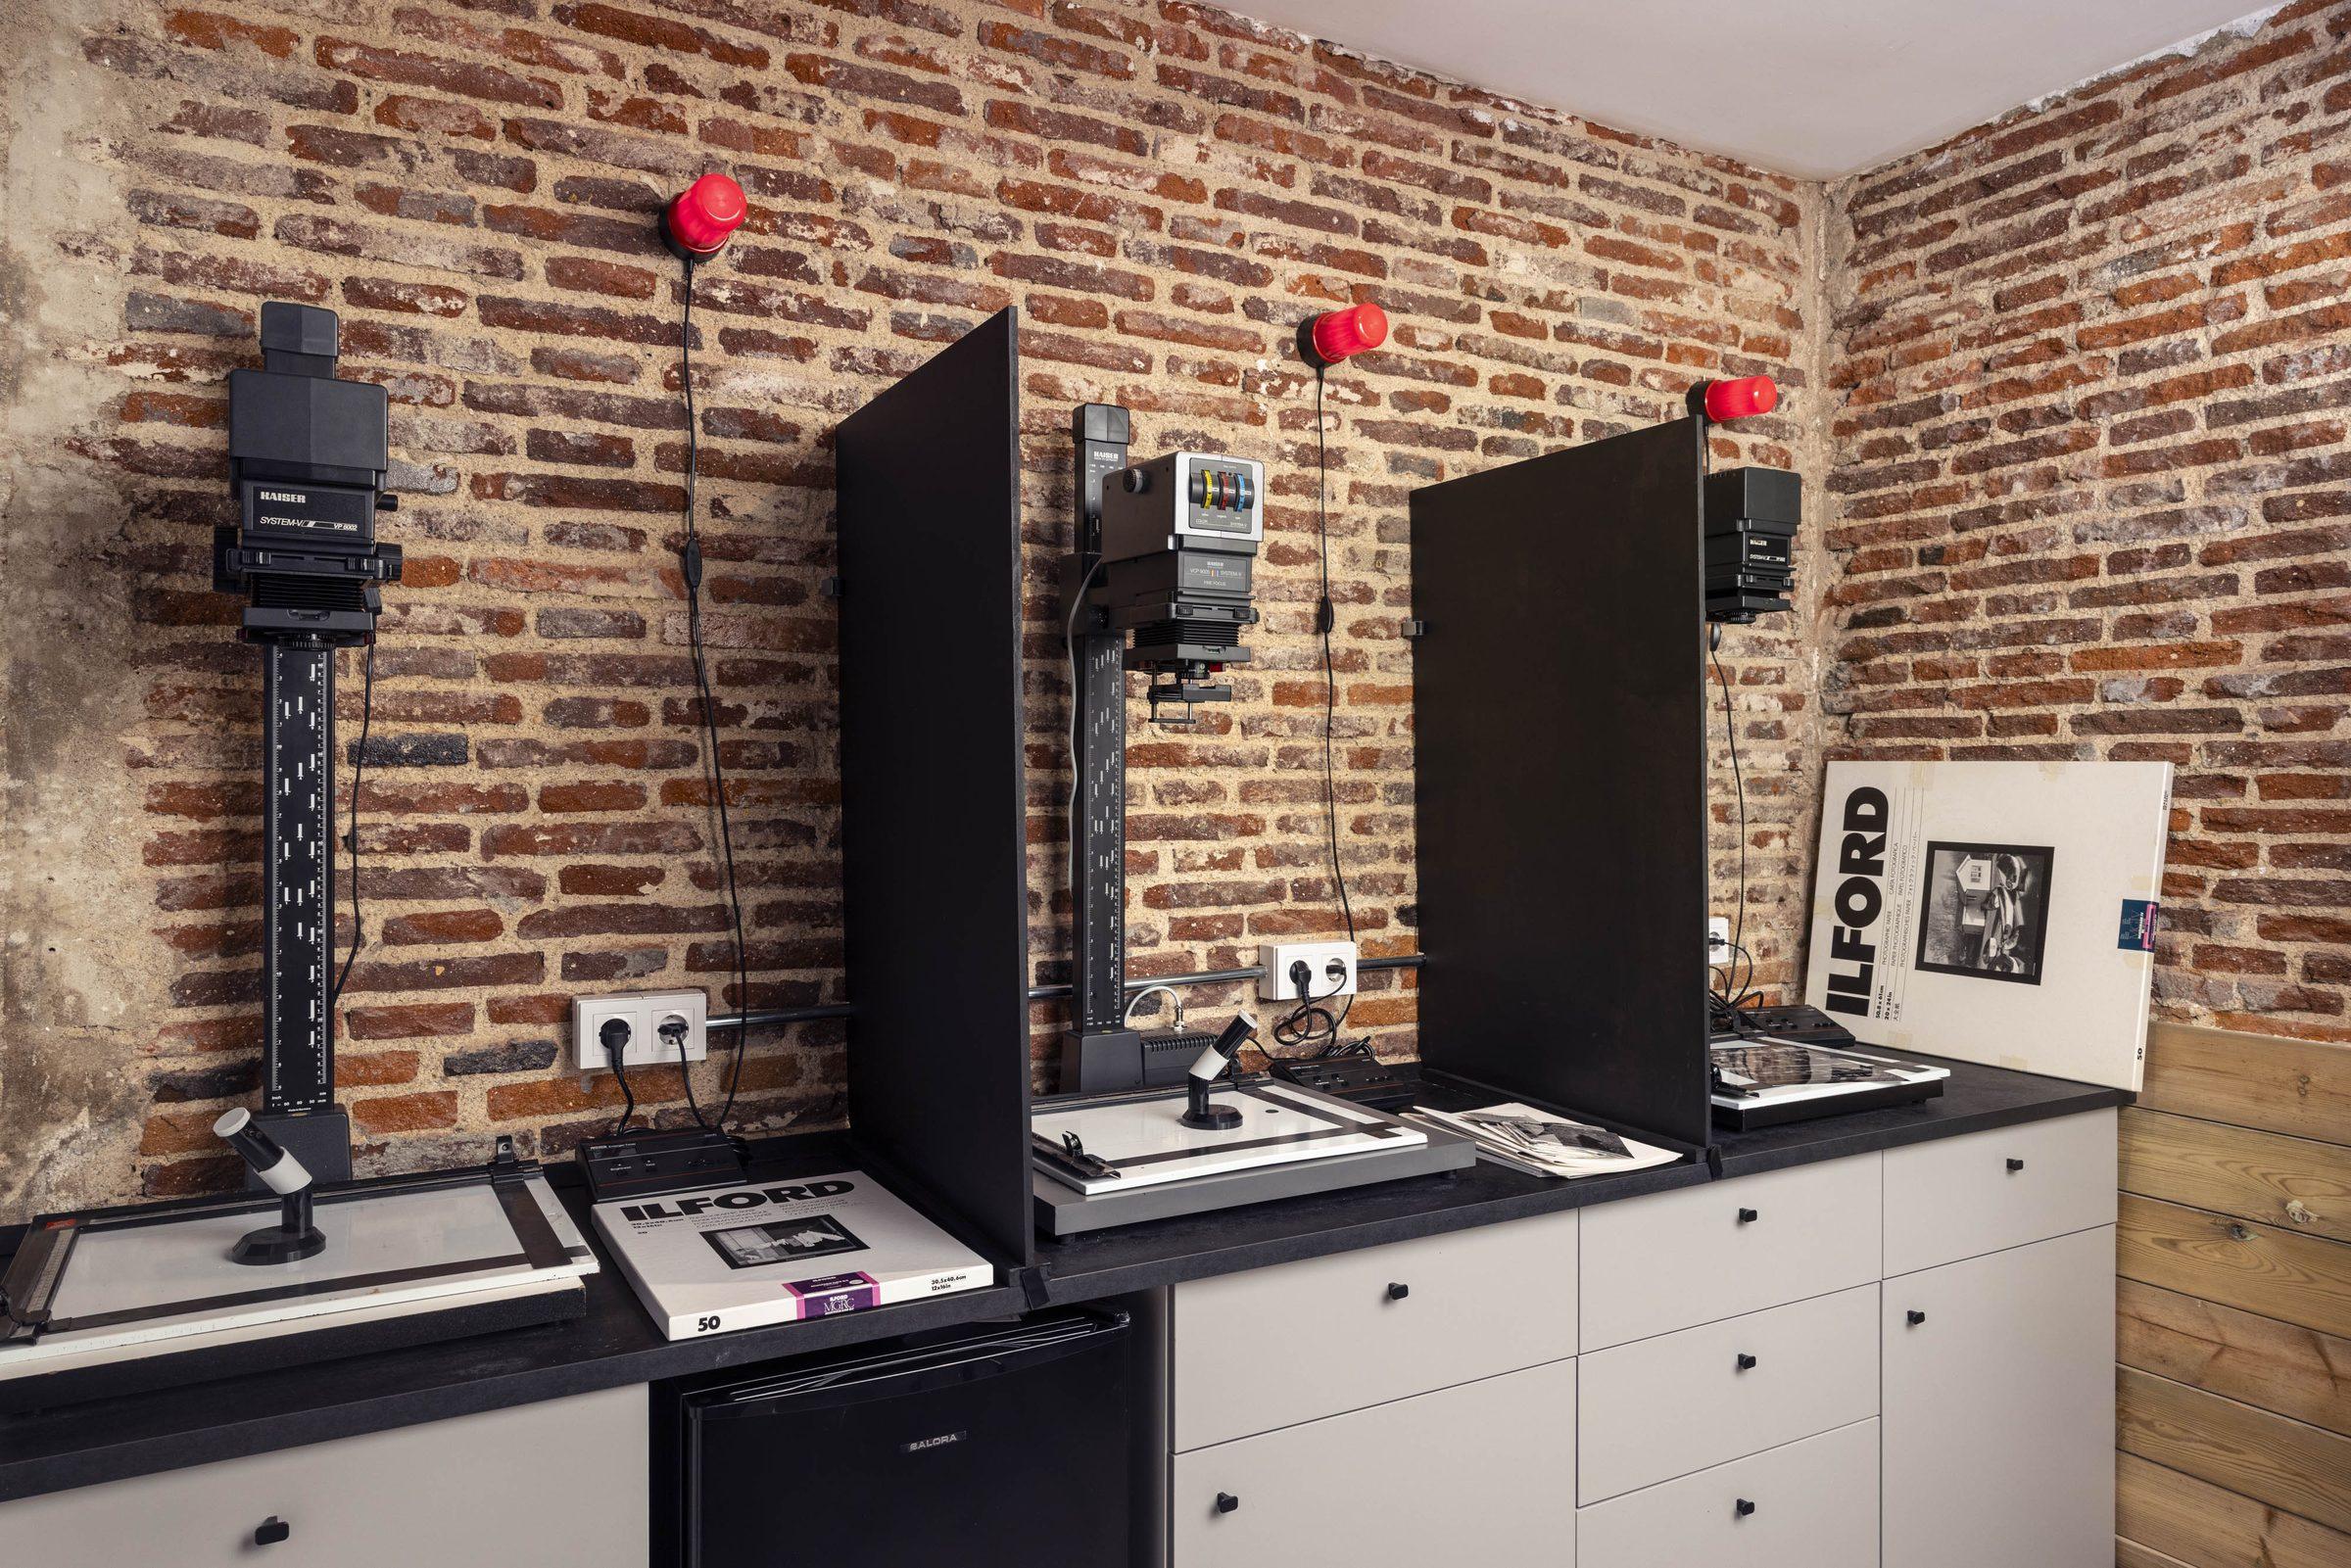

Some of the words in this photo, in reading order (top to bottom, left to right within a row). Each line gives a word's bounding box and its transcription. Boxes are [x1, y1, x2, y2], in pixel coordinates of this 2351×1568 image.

[260, 491, 306, 503] KAISER
[260, 516, 303, 527] SYSTEM-V
[1825, 786, 1889, 1017] ILFORD
[1882, 926, 1891, 965] PHOTOGRAPHIC
[2137, 1048, 2142, 1060] 50
[620, 1181, 855, 1221] ILFORD
[824, 1298, 855, 1312] MGRC
[698, 1315, 720, 1332] 50
